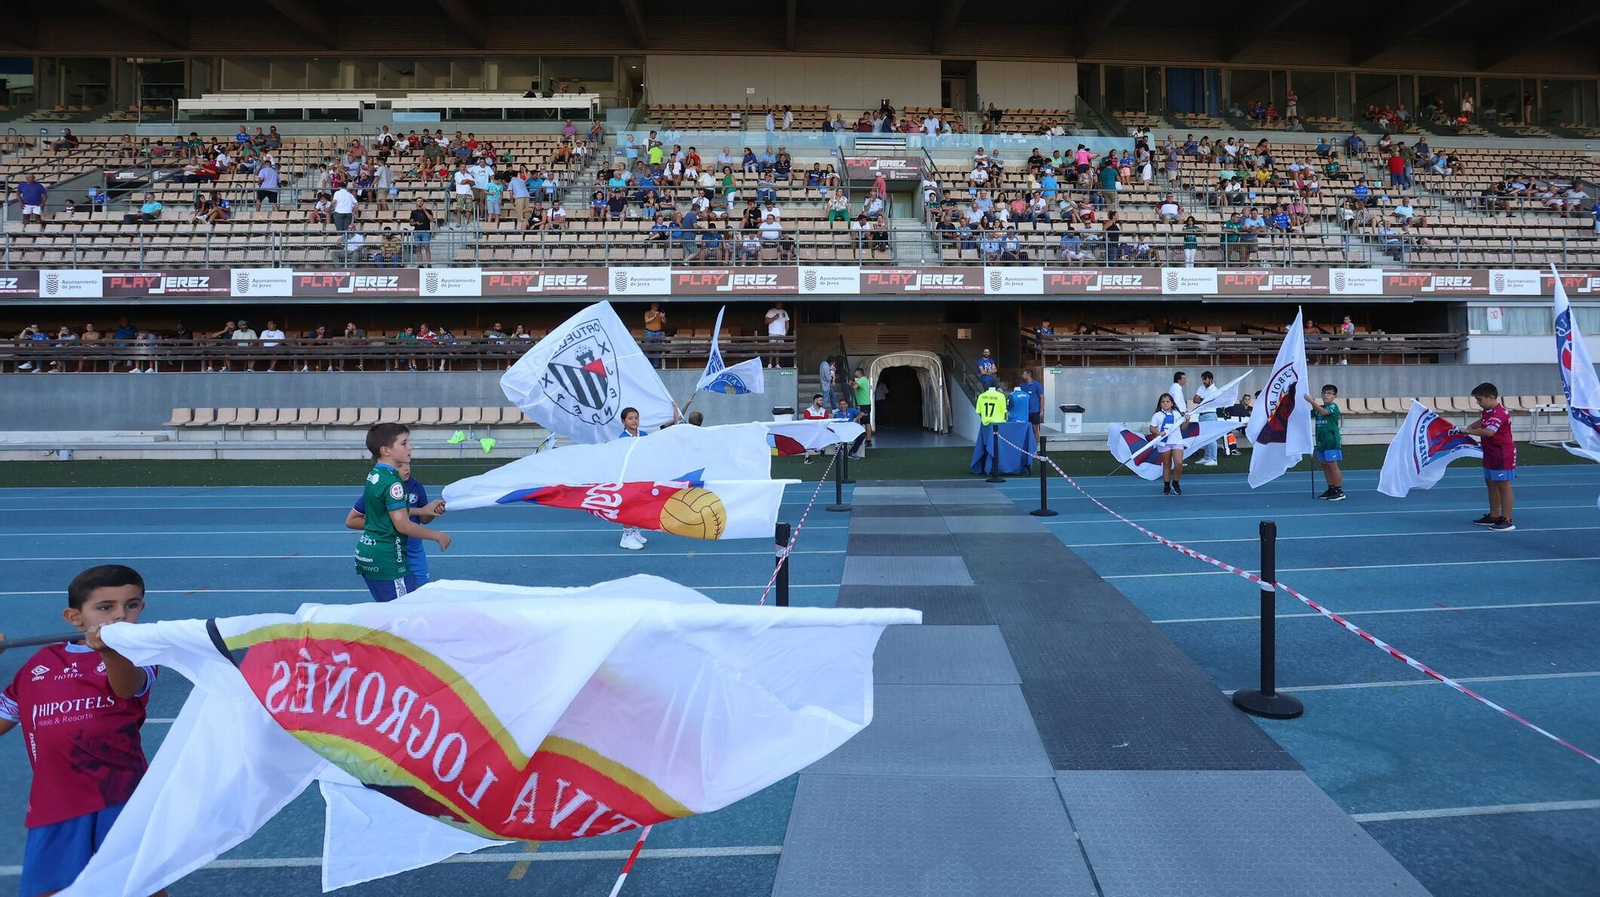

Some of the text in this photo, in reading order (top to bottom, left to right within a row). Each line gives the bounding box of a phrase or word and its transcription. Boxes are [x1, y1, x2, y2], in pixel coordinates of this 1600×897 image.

[869, 159, 906, 170] JEREZ
[110, 276, 210, 294] PLAY JEREZ
[300, 276, 399, 293] PLAY JEREZ
[489, 275, 588, 292] PLAY JEREZ
[679, 274, 778, 291] PLAY JEREZ
[868, 274, 964, 291] PLAY JEREZ
[1051, 275, 1142, 291] PLAY JEREZ
[1225, 274, 1312, 290] PLAY JEREZ
[1389, 276, 1472, 292] PLAY JEREZ
[984, 403, 996, 417] 17
[38, 695, 116, 718] HIPOTELS
[62, 712, 93, 723] Resorts
